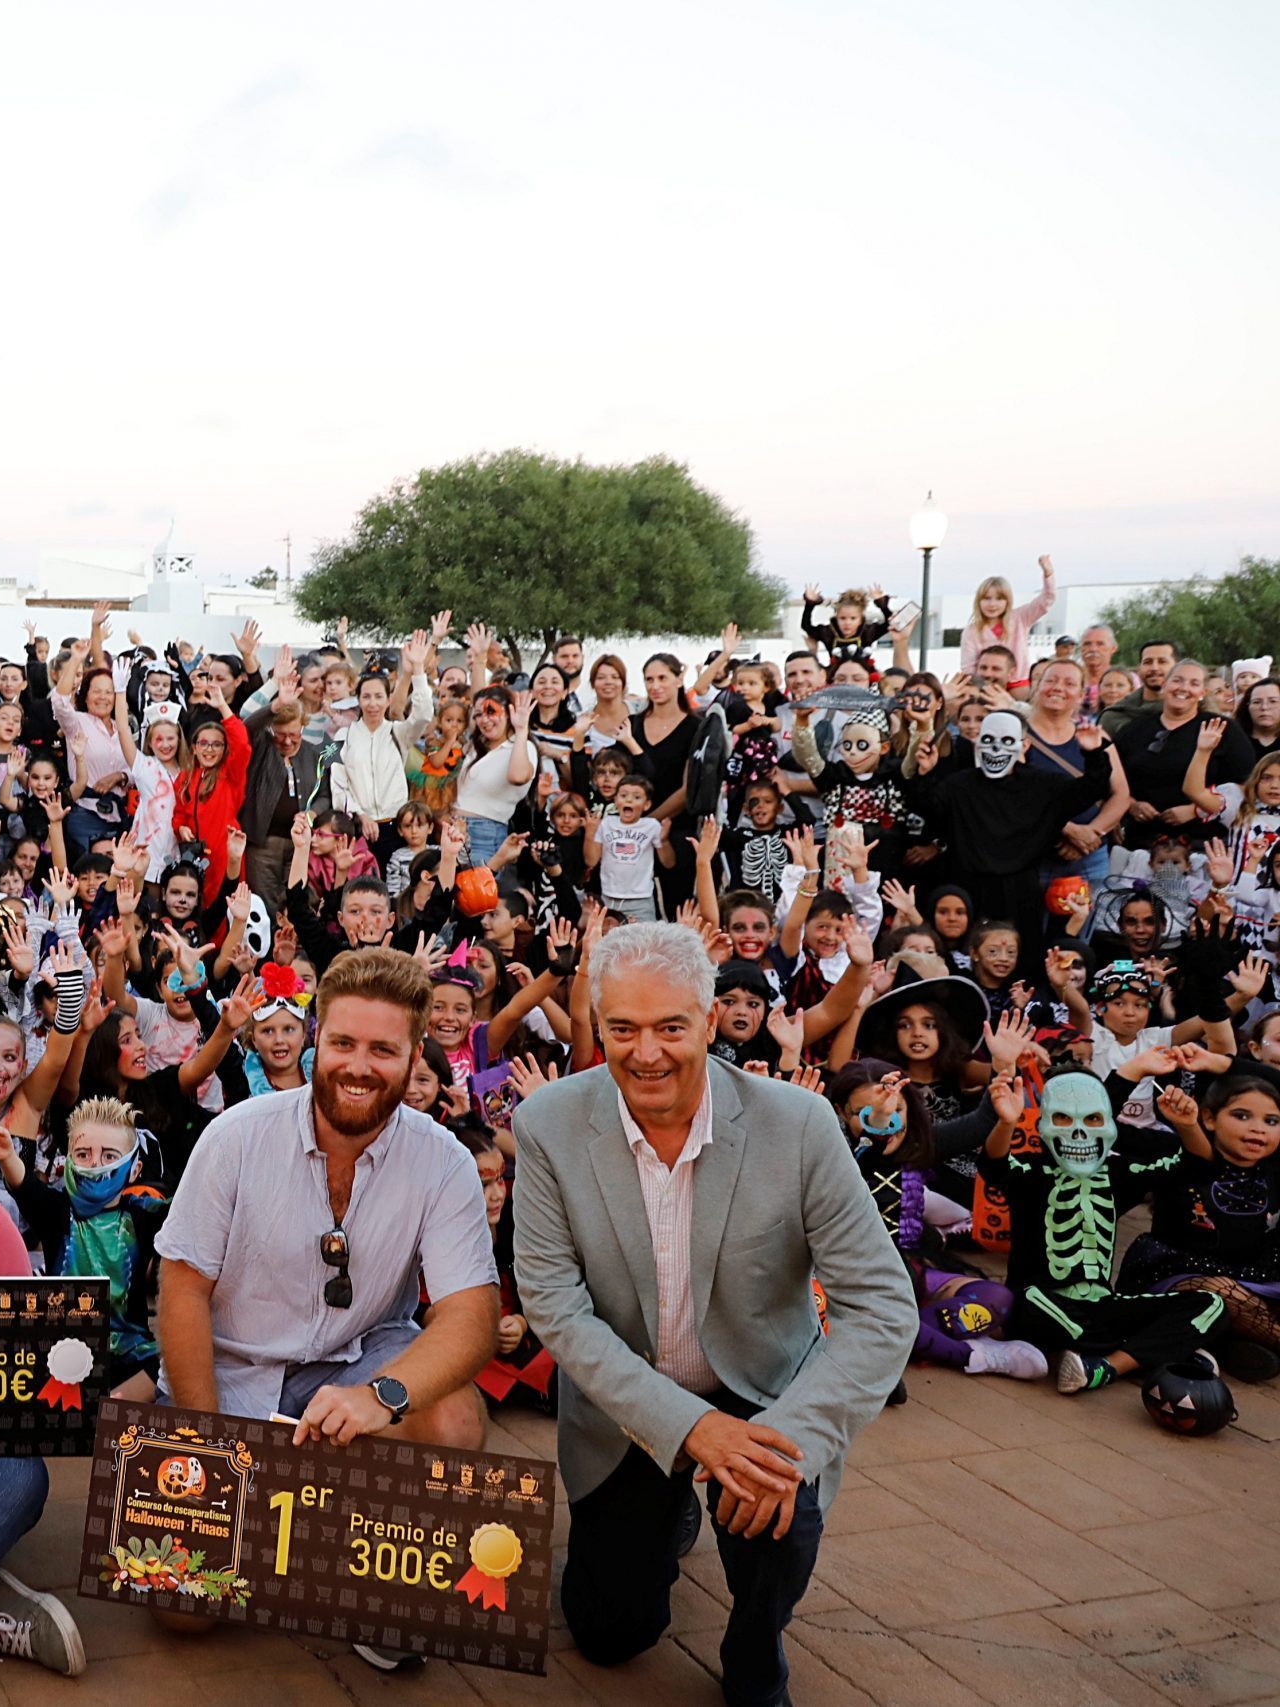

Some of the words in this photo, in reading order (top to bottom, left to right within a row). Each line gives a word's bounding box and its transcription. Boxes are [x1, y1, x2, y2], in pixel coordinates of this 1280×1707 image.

[14, 1348, 36, 1366] de
[125, 1507, 185, 1531] Halloween
[191, 1518, 230, 1538] Finaos
[126, 1496, 163, 1511] Concurso
[163, 1501, 173, 1513] de
[173, 1505, 231, 1522] escaparatismo
[349, 1512, 425, 1543] Premio
[432, 1526, 457, 1548] de
[348, 1537, 453, 1590] 300€
